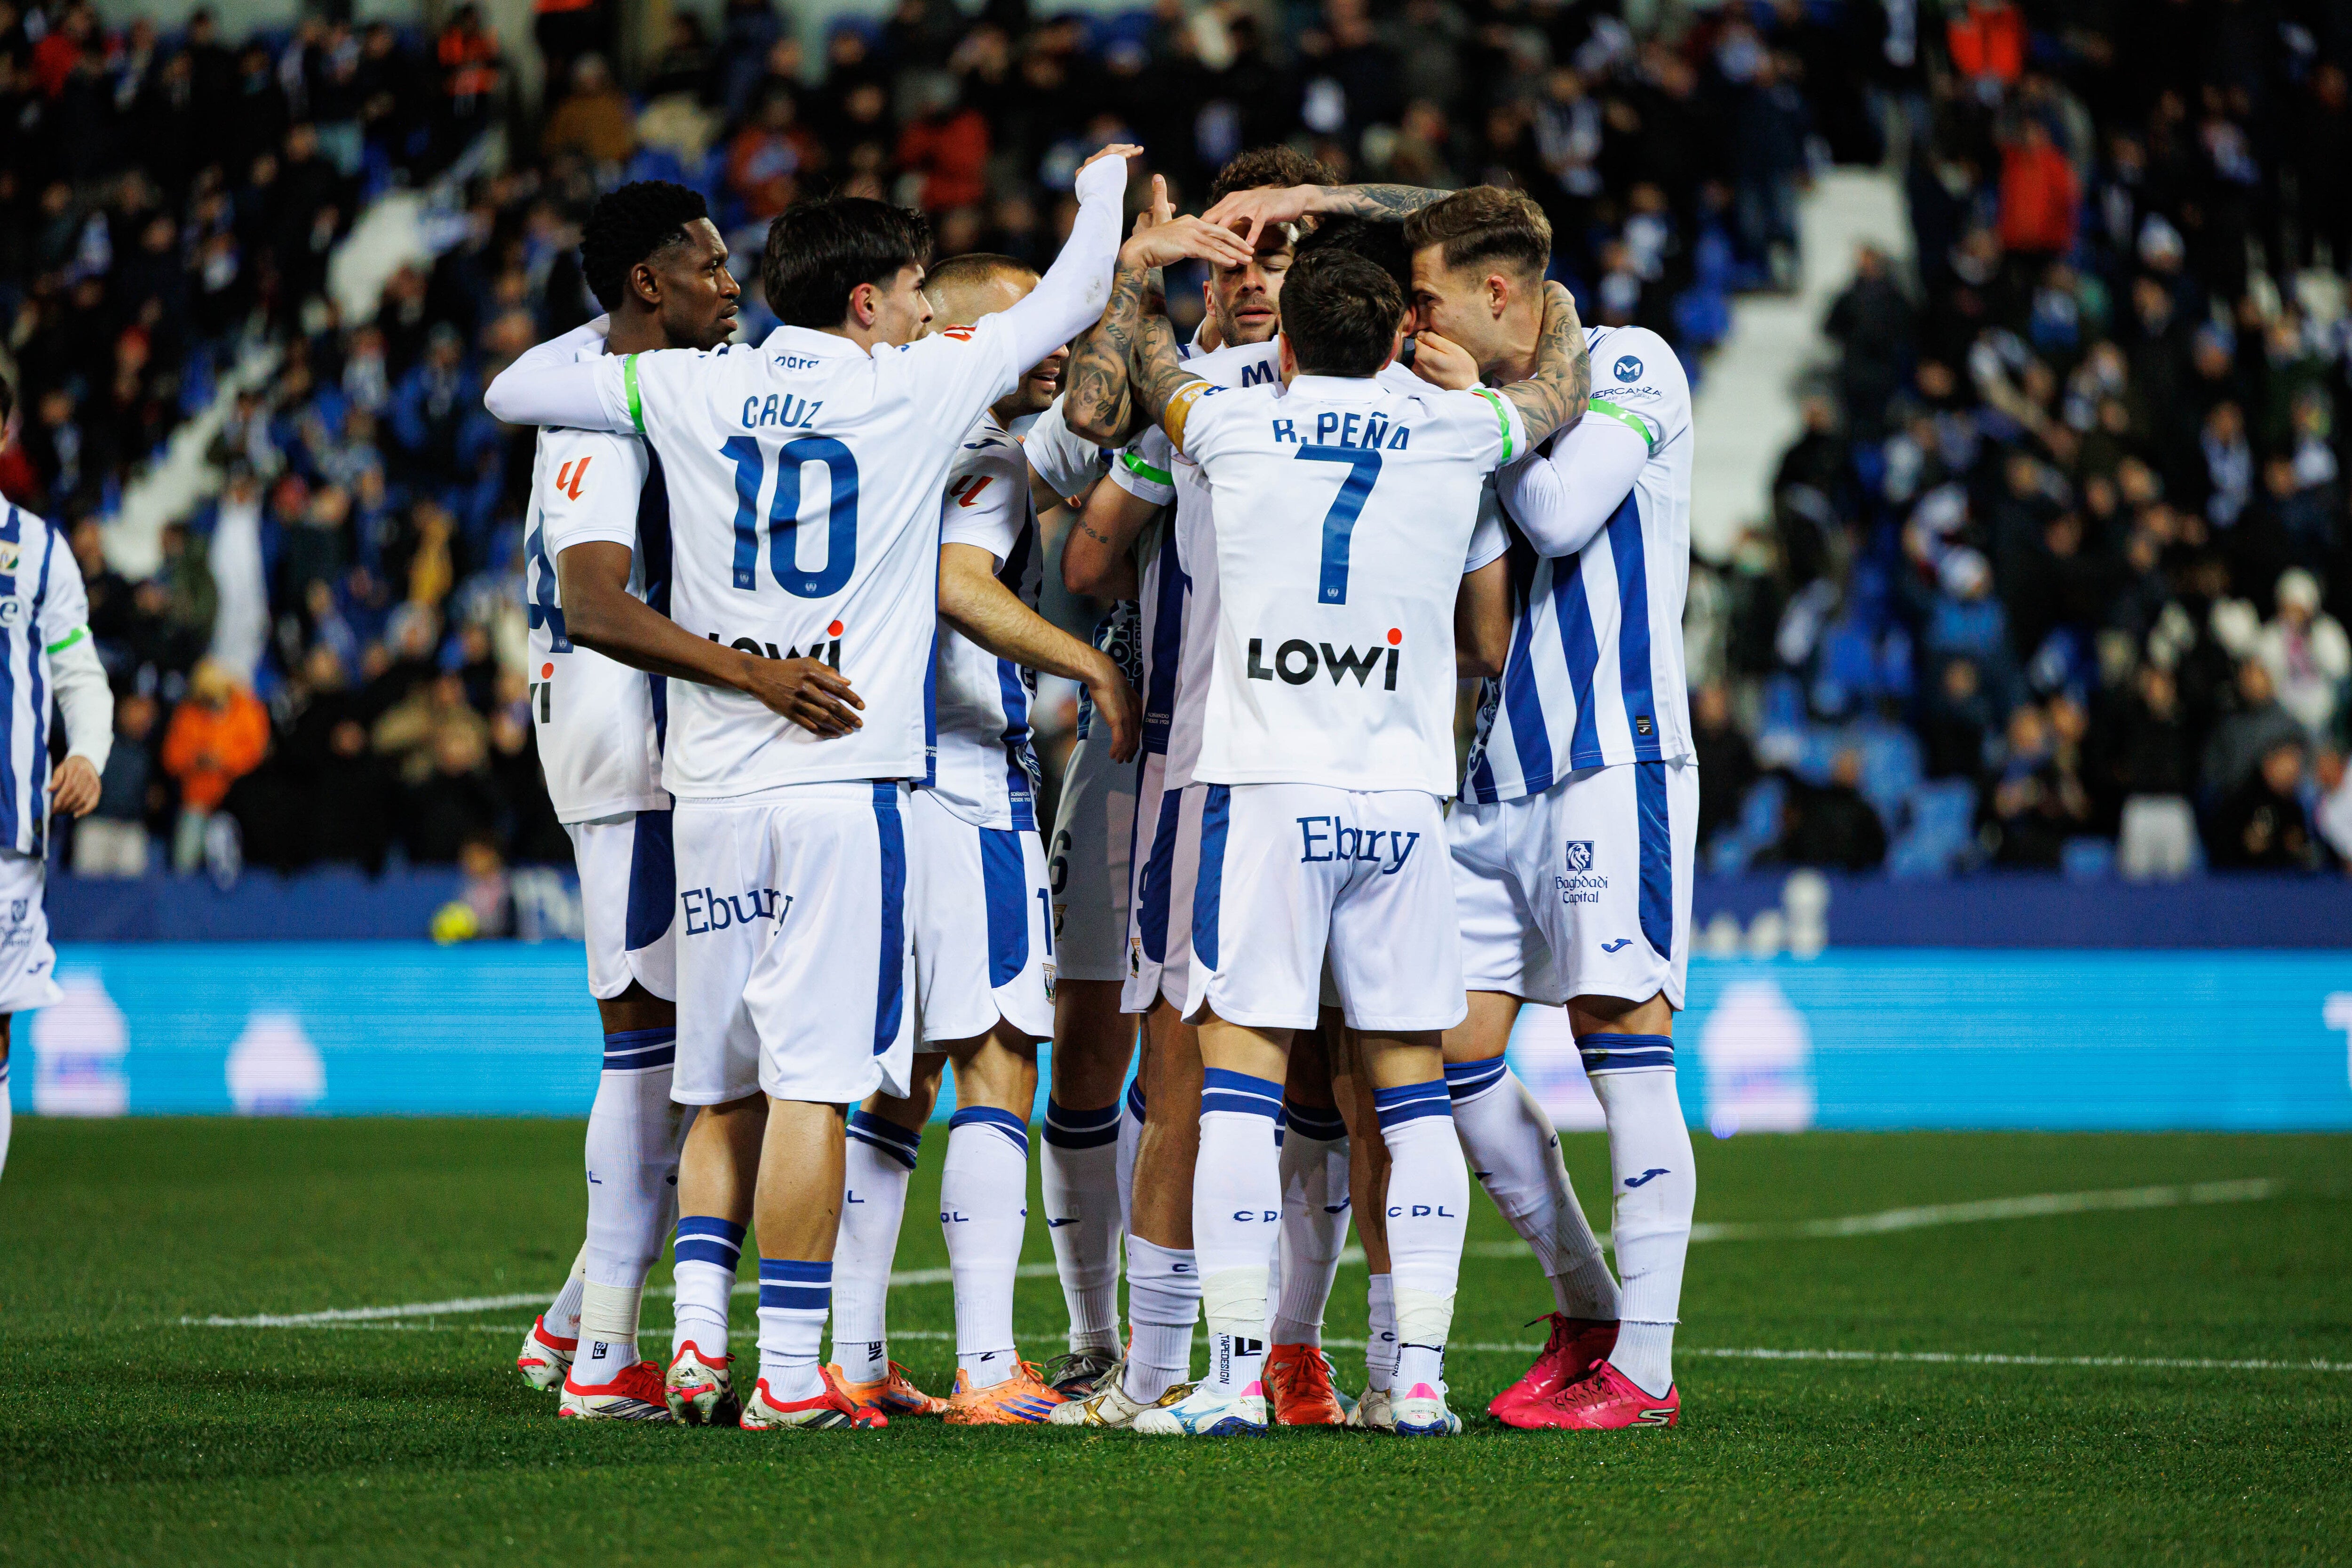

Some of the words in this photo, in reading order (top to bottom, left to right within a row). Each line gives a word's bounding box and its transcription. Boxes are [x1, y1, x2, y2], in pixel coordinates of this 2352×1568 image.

[742, 394, 823, 429] CRUZ
[1317, 412, 1410, 450] PEÑA
[718, 436, 859, 598] 10
[1294, 444, 1383, 605] 7
[1296, 816, 1420, 875] Ebury
[1555, 876, 1608, 891] Baghdadi
[1563, 891, 1599, 906] Capital
[681, 887, 794, 936] Ebury
[1388, 1205, 1454, 1218] CDL
[594, 1343, 607, 1357] FS
[1219, 1335, 1230, 1385] TAPEDESIGN
